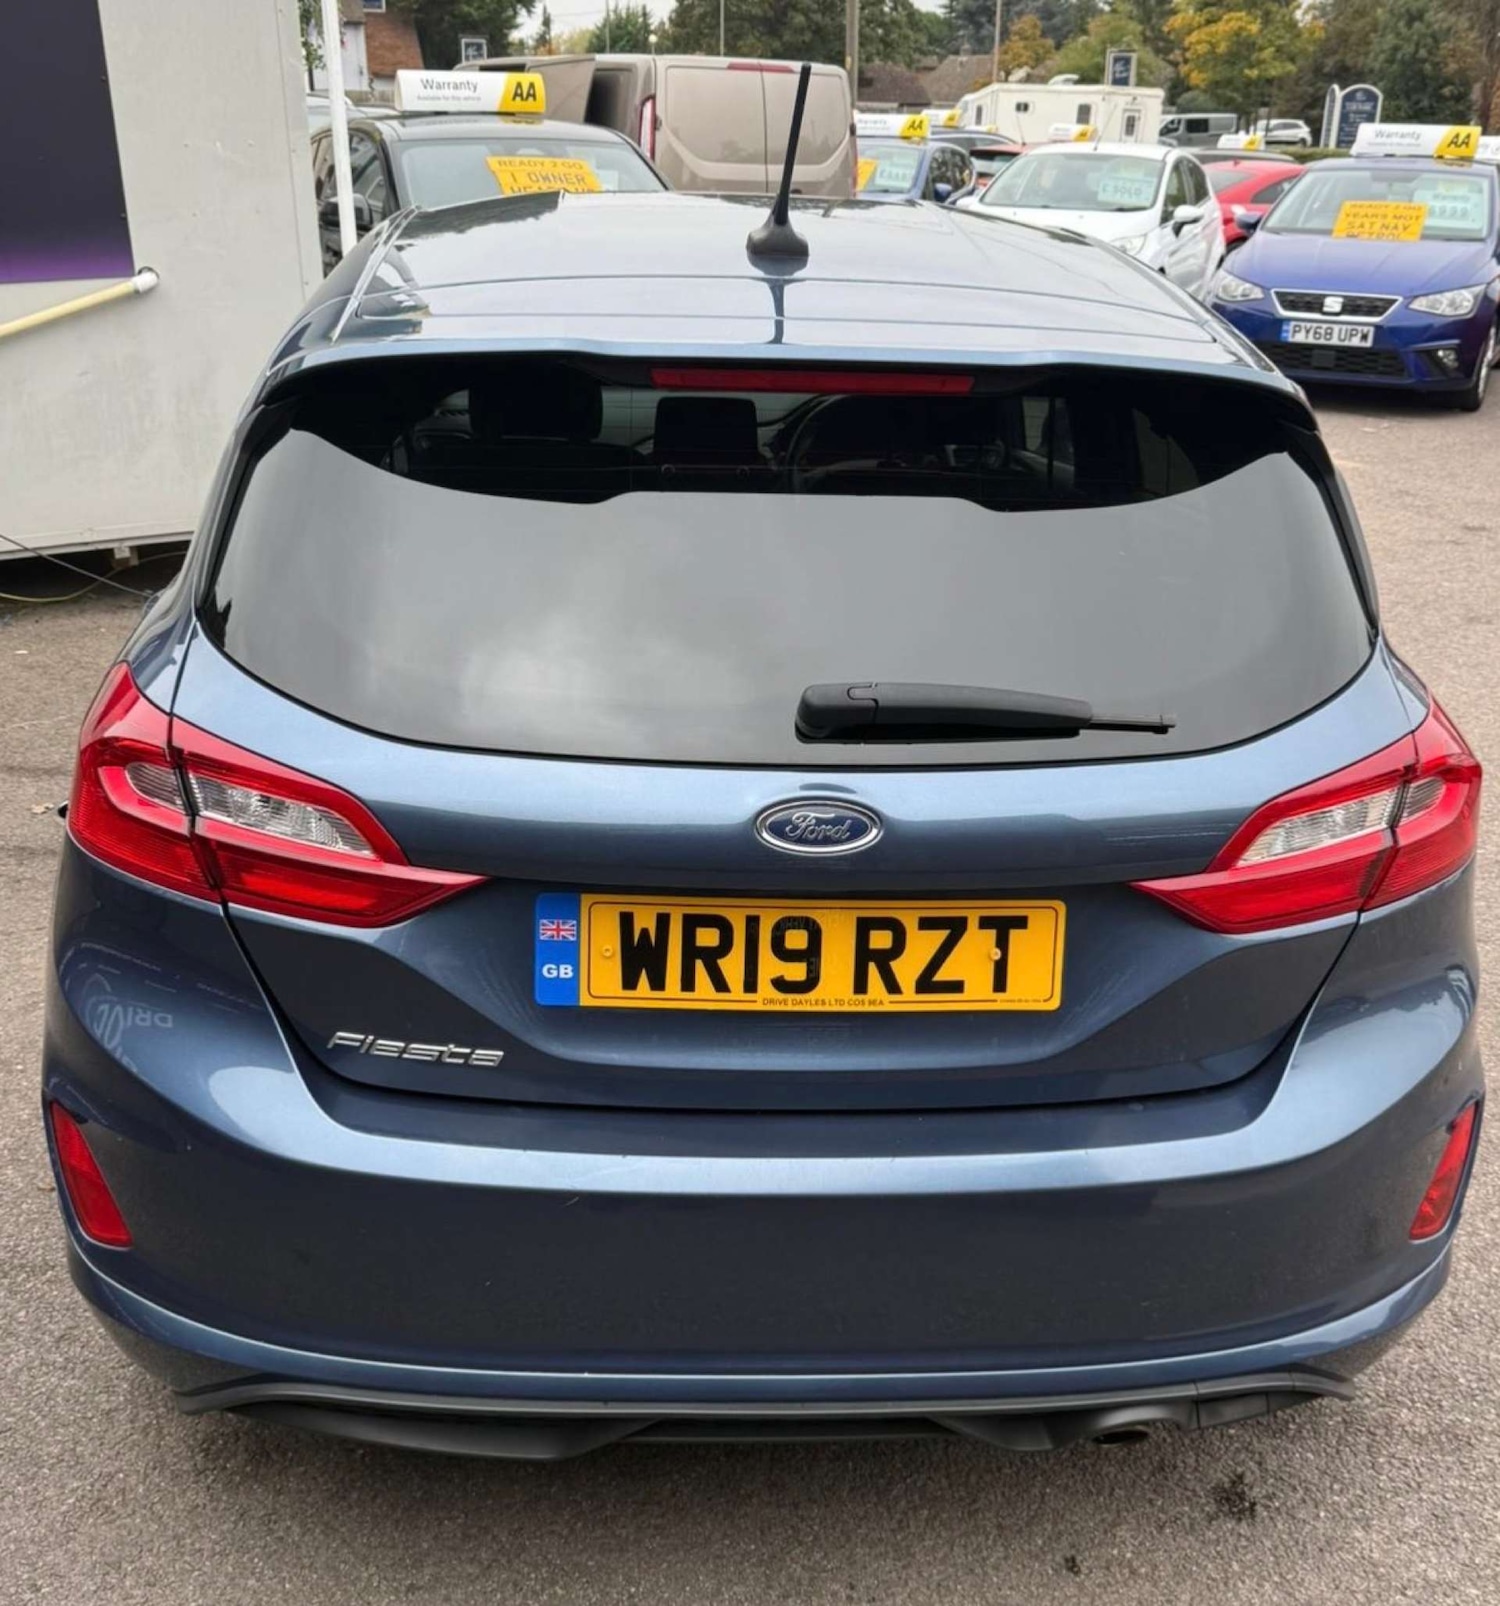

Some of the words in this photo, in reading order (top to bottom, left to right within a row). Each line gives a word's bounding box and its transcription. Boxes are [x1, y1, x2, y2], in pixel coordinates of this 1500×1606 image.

[420, 78, 478, 93] Warranty
[511, 82, 537, 102] AA
[907, 120, 924, 131] AA
[1374, 130, 1422, 141] Warranty
[1447, 132, 1471, 149] AA
[497, 159, 545, 168] READY
[550, 160, 558, 169] 2
[527, 171, 588, 186] OWNER
[1346, 221, 1377, 231] SAT
[1380, 222, 1412, 232] NAV
[1291, 324, 1334, 342] PY68
[1337, 326, 1371, 344] UPW
[785, 811, 853, 840] Ford
[618, 910, 824, 995] WR19
[853, 914, 1028, 995] RZT
[542, 963, 574, 979] GB
[762, 997, 789, 1006] DRIVE
[828, 998, 846, 1007] LTD
[327, 1031, 504, 1067] Fiesta
